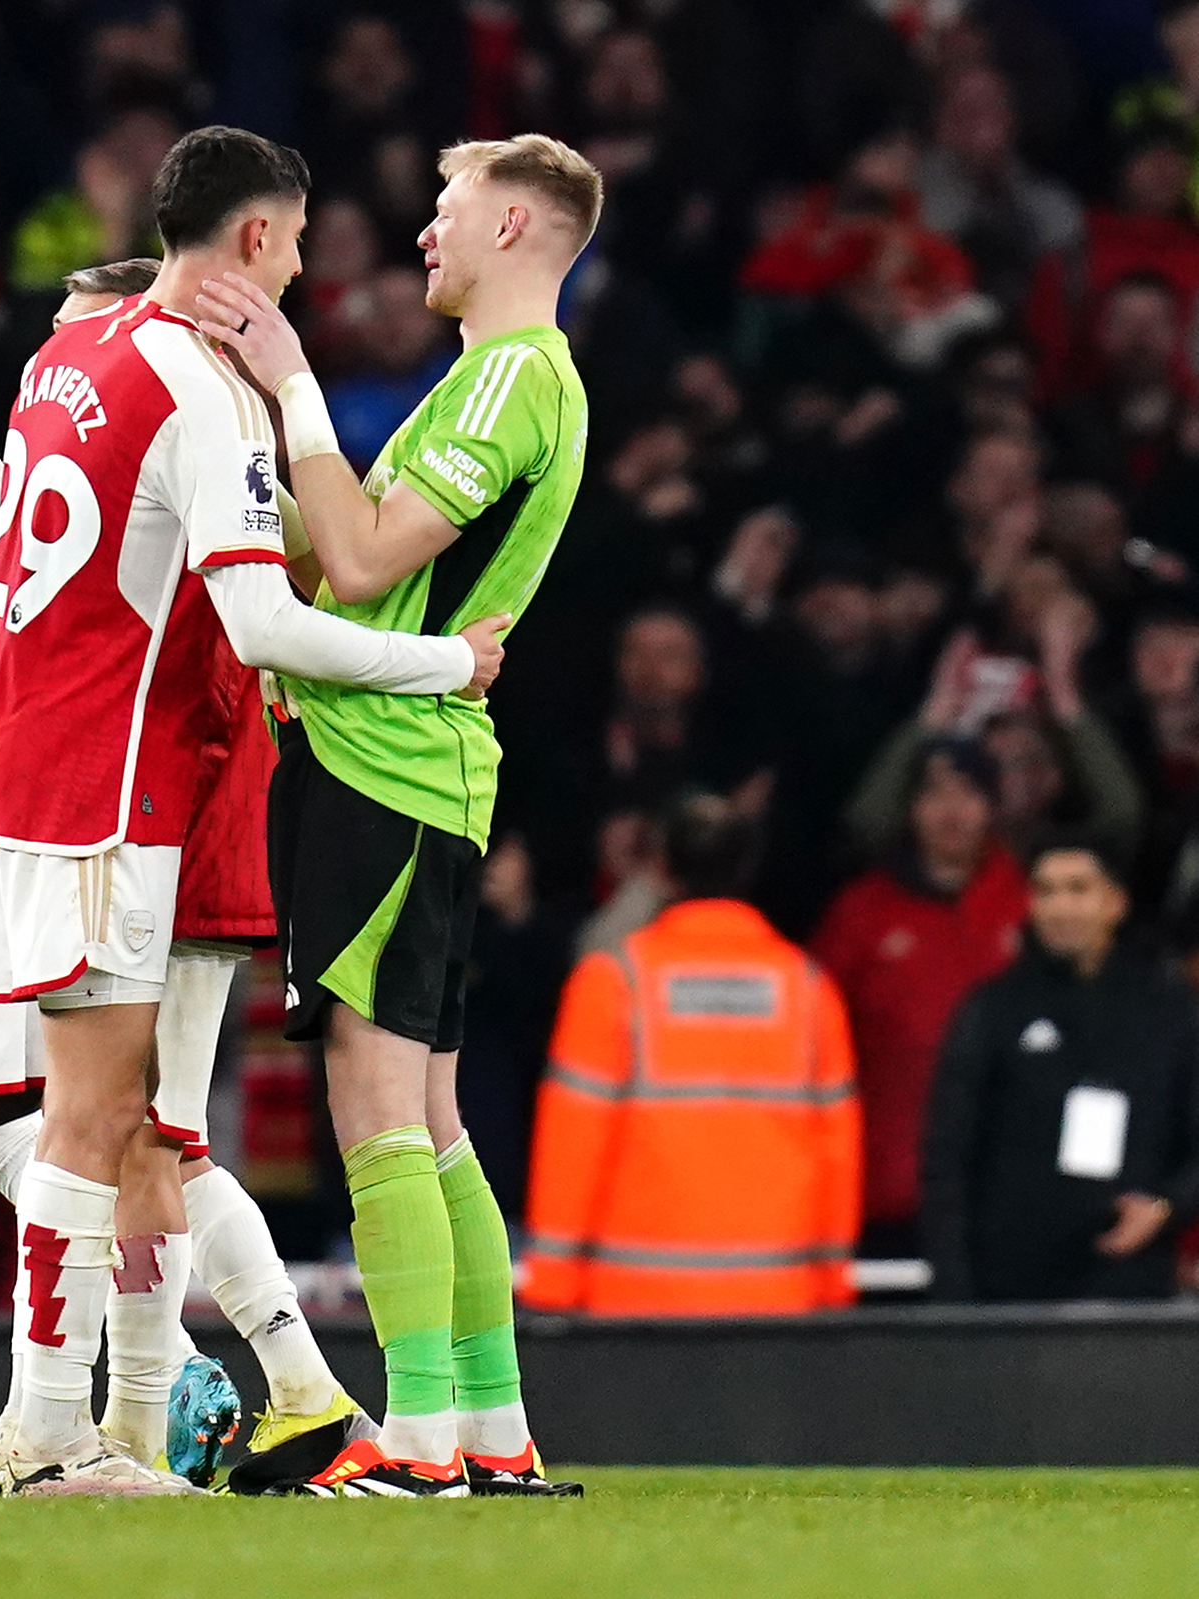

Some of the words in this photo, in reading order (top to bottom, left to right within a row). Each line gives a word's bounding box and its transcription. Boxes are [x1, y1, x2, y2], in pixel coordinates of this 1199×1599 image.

[17, 364, 108, 443] HAVERTZ
[421, 447, 487, 505] RWANDA
[444, 441, 487, 479] VISIT
